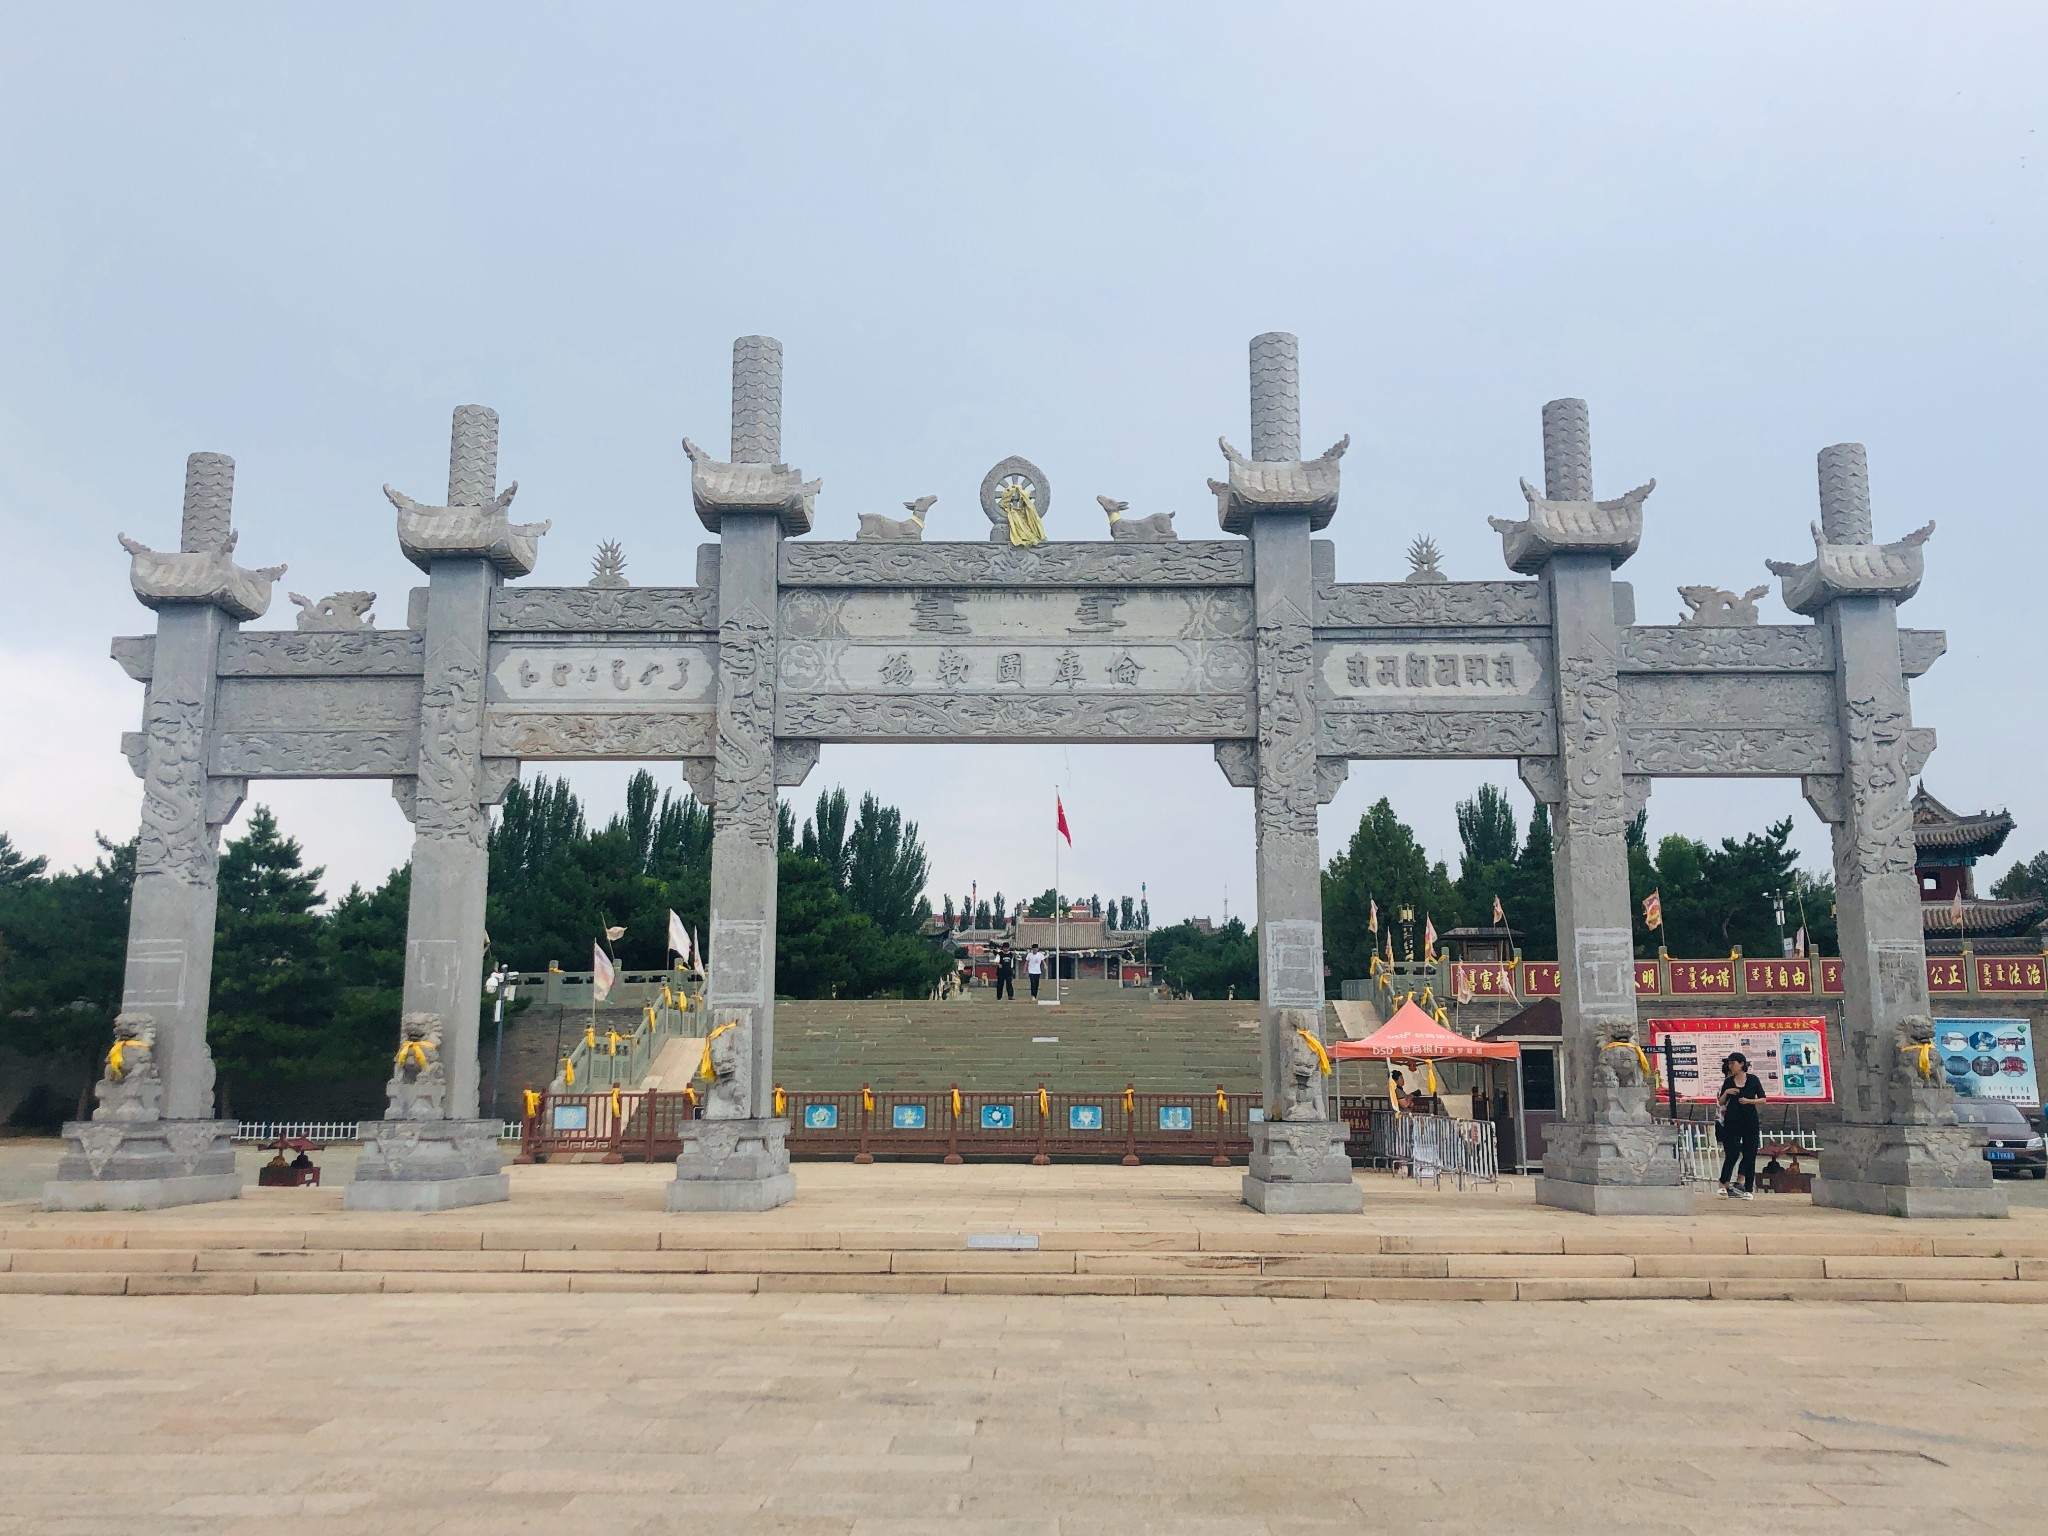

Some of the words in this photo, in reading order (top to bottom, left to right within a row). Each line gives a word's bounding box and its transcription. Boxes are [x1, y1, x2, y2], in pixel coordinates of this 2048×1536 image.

[1700, 967, 1730, 989] 和谐
[1779, 966, 1805, 988] 自由
[1930, 964, 1961, 985] 公正
[2009, 963, 2040, 985] 法治
[1401, 1044, 1444, 1055] 包商银行
